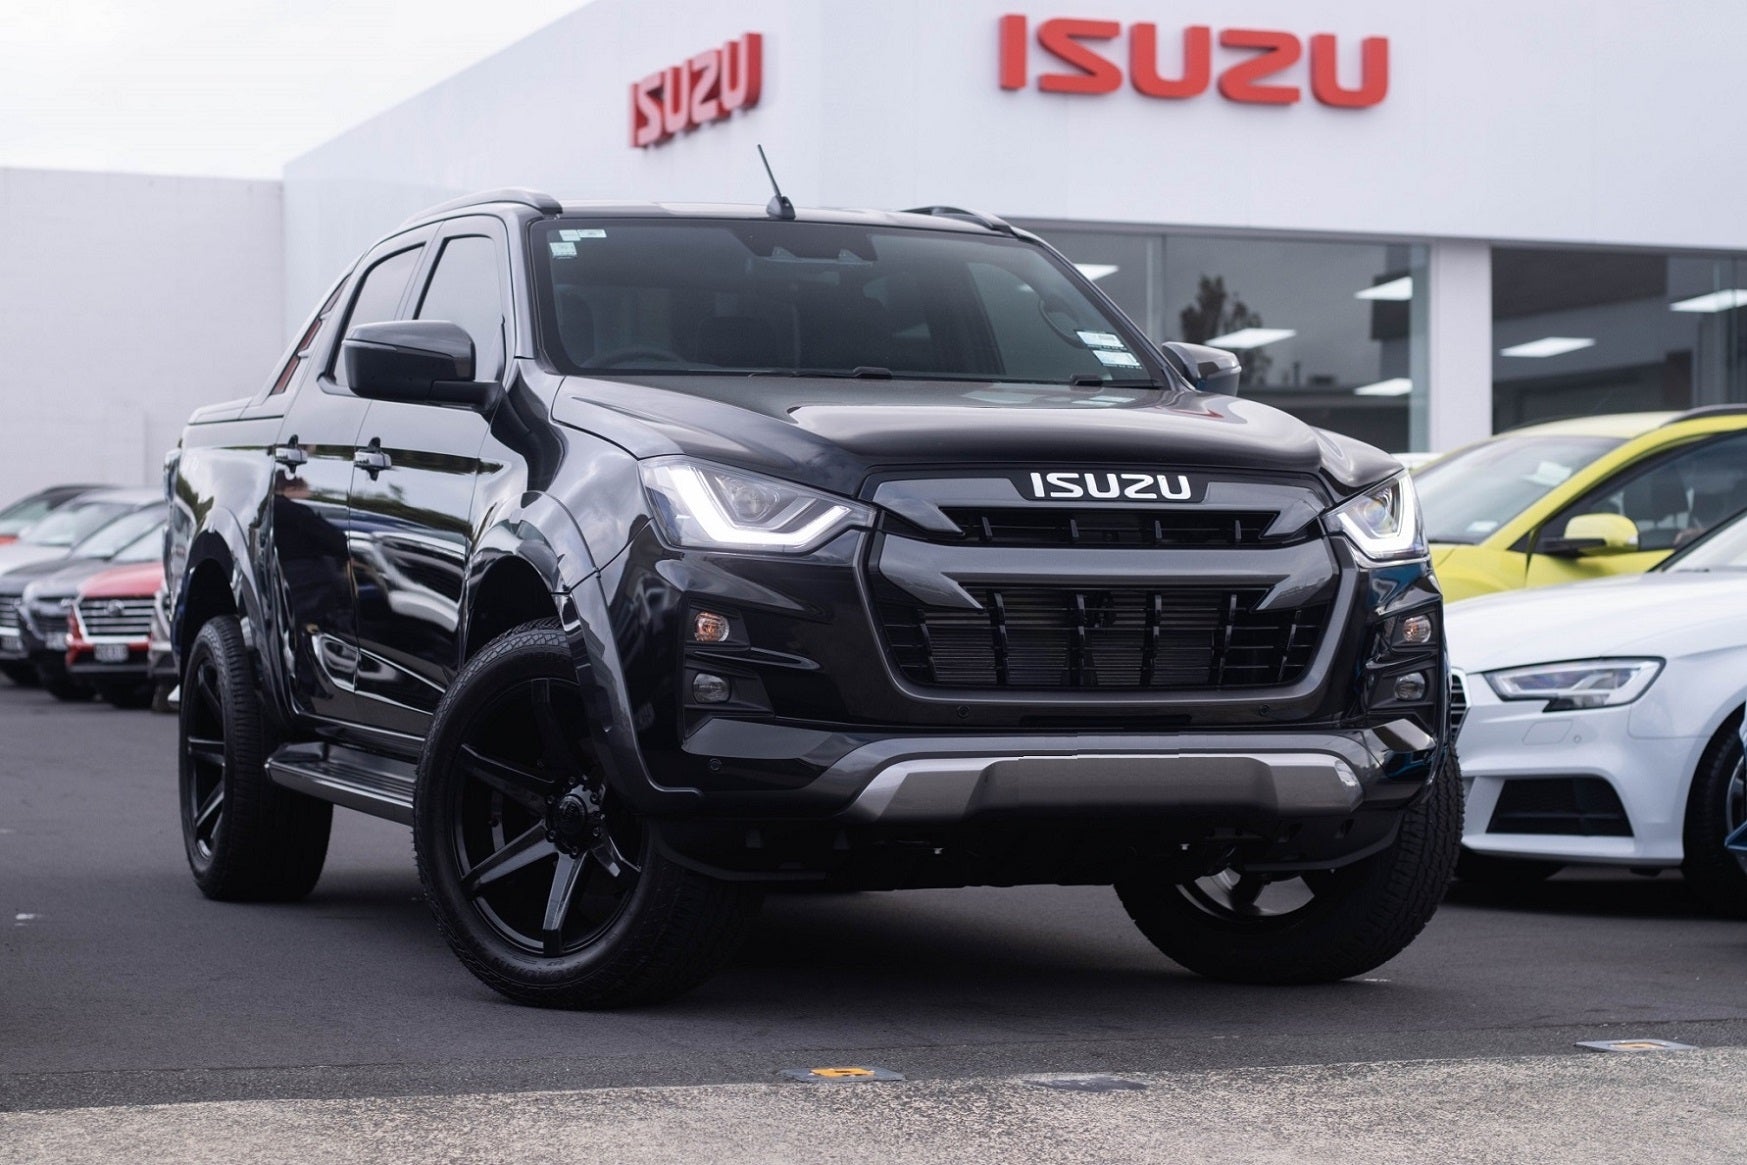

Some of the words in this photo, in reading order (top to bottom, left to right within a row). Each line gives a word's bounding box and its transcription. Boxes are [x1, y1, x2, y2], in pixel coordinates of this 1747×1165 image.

[629, 32, 763, 148] ISUZU
[998, 14, 1390, 108] ISUZU
[1030, 472, 1192, 500] ISUZU
